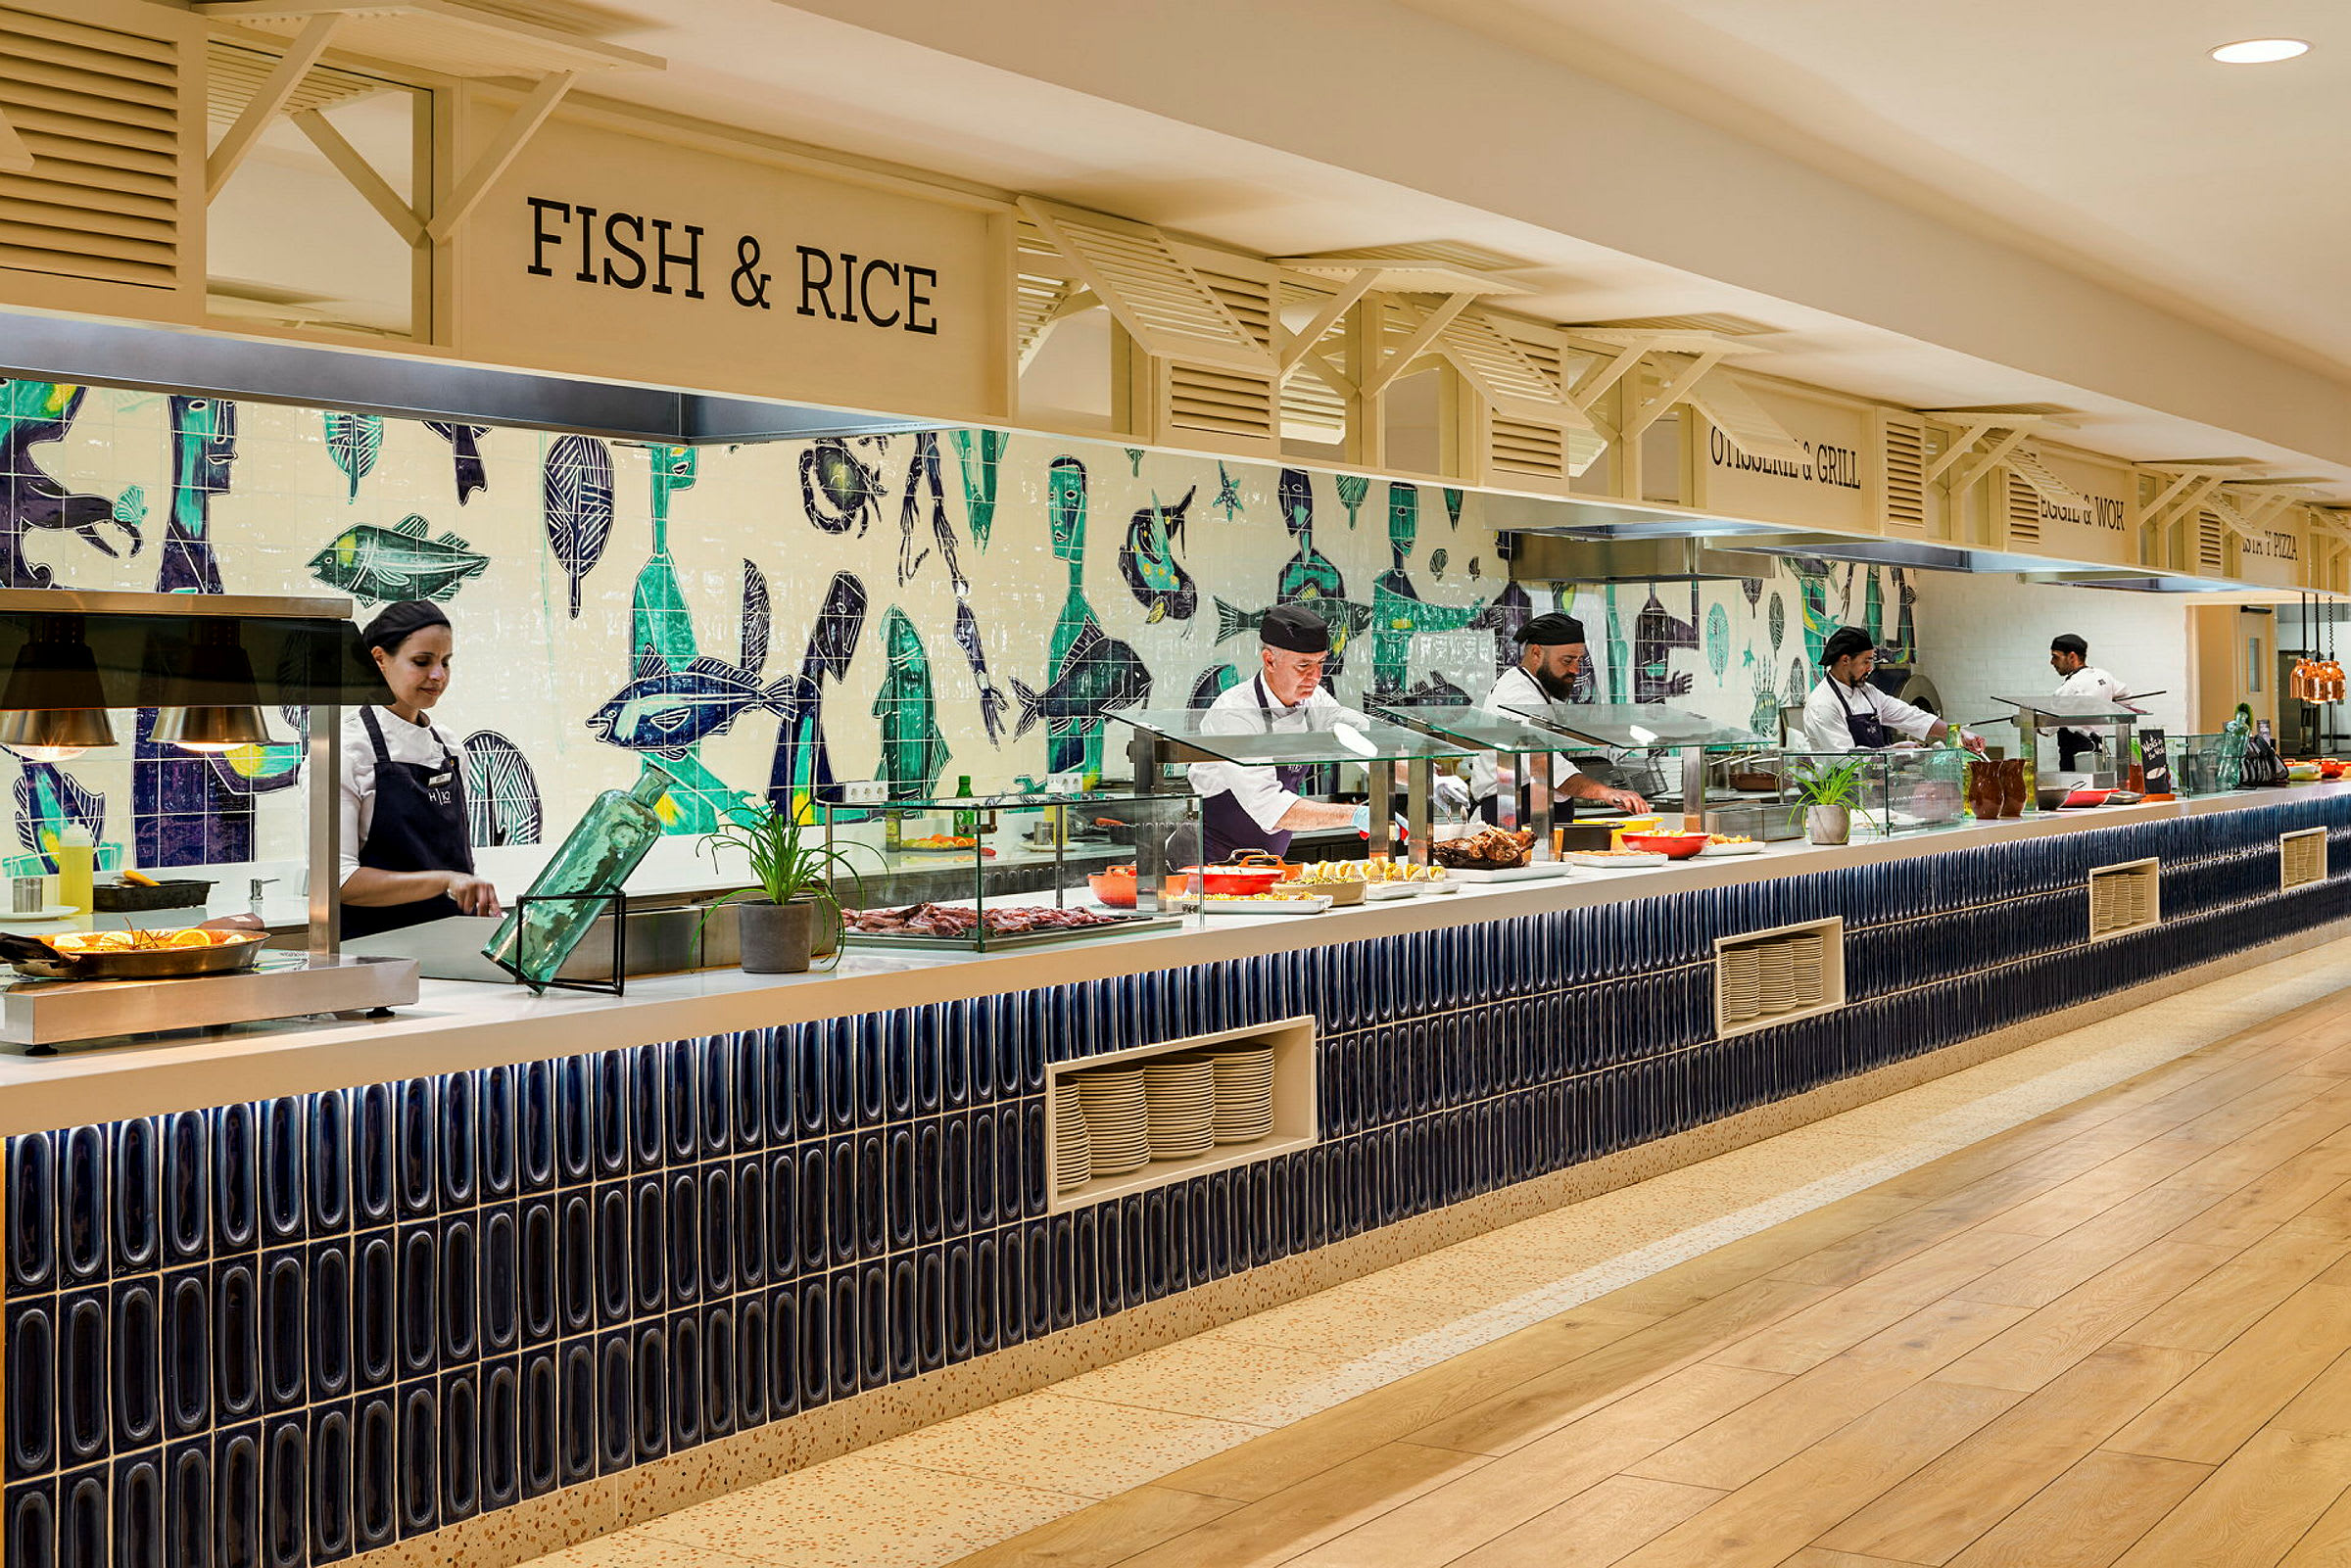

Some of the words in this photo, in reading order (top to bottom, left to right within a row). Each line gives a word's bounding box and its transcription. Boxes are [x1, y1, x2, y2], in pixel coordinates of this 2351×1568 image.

[527, 196, 705, 300] FISH
[731, 235, 772, 310] &
[795, 244, 937, 335] RICE
[1817, 444, 1861, 490] GRILL
[2094, 496, 2125, 532] WOK
[2274, 532, 2298, 561] PIZZA
